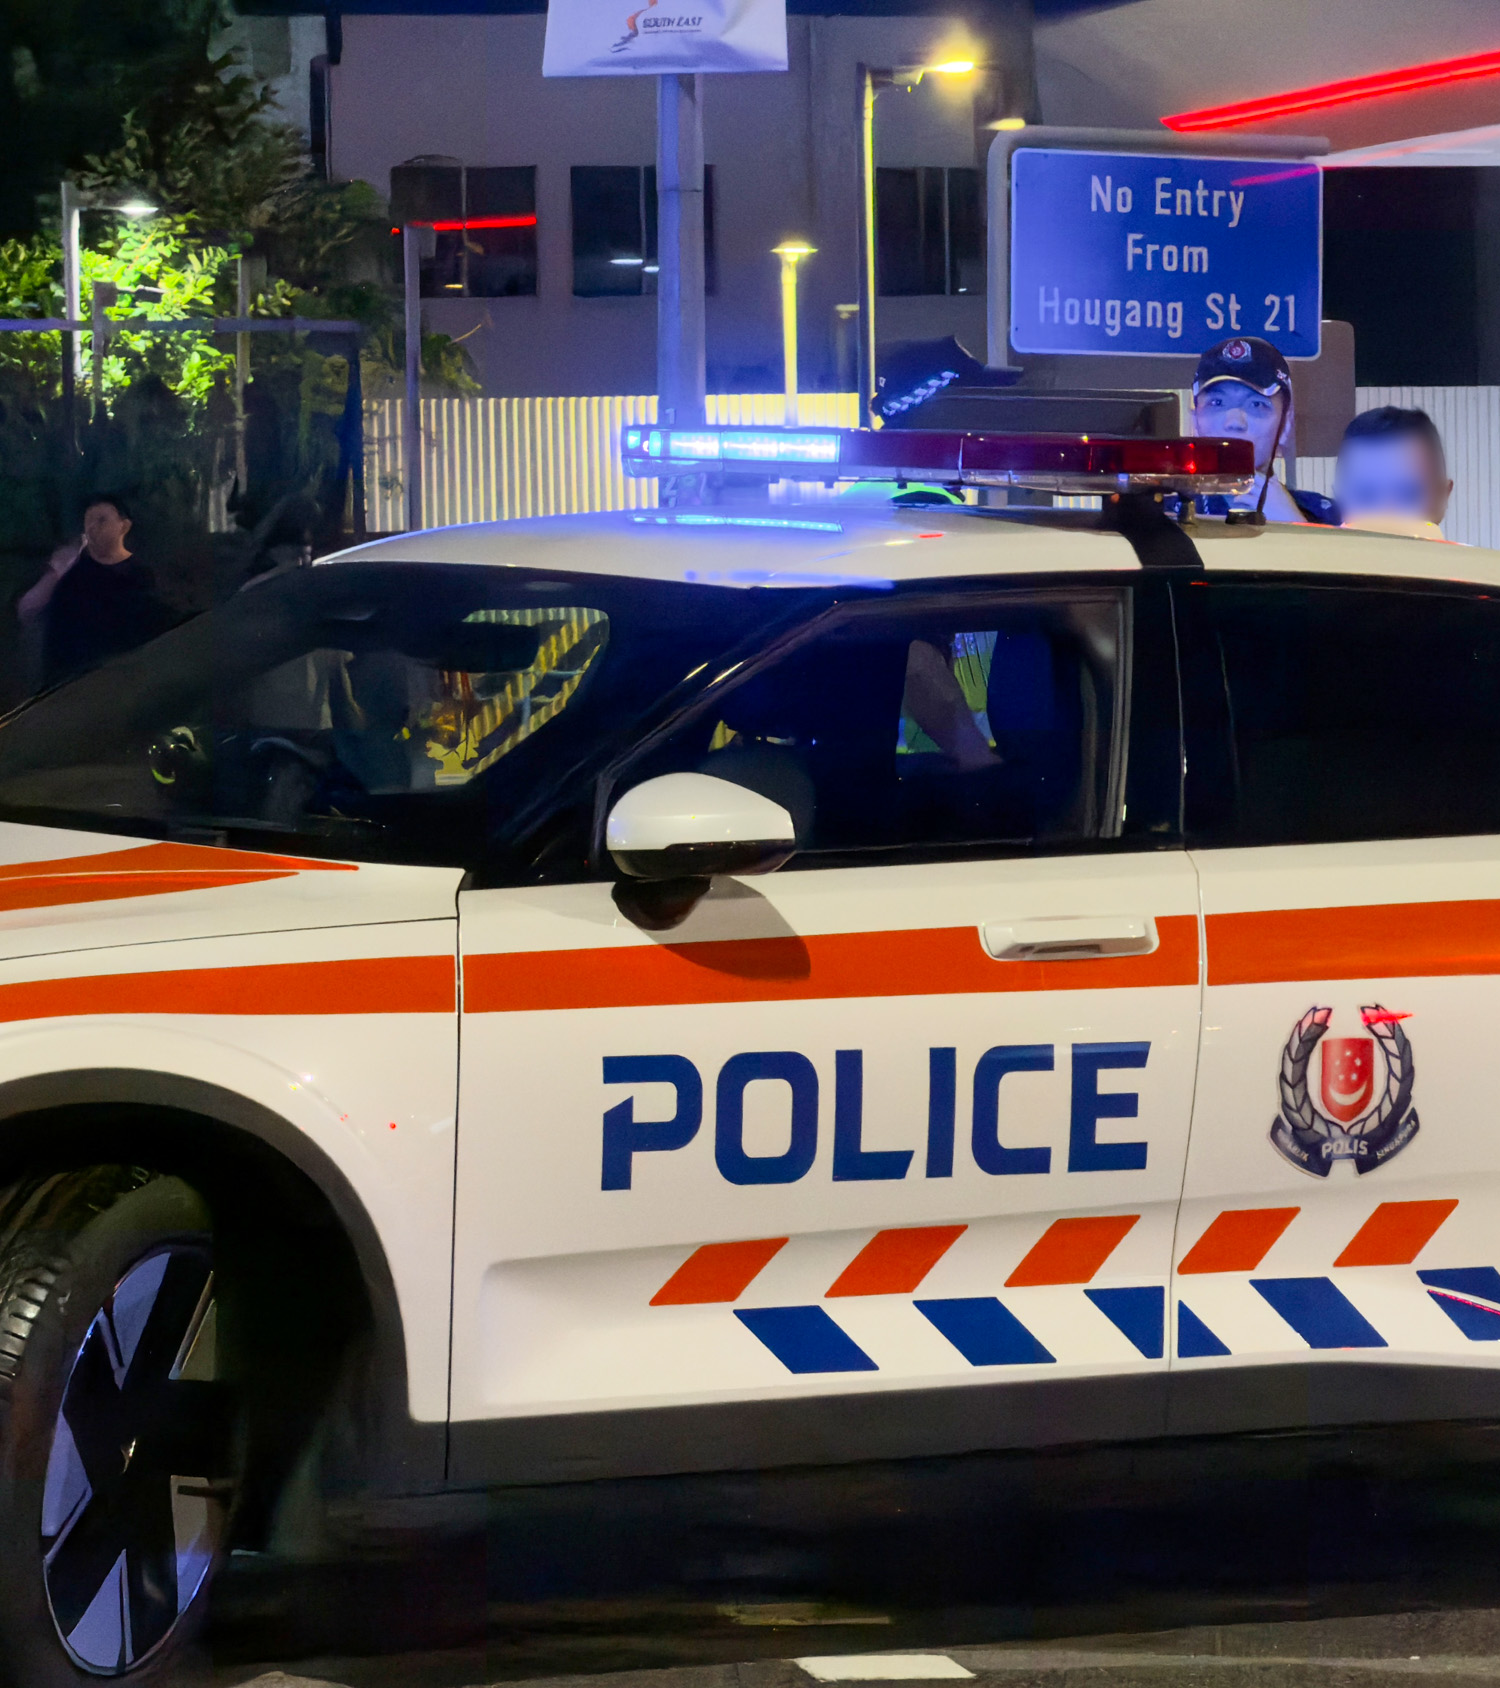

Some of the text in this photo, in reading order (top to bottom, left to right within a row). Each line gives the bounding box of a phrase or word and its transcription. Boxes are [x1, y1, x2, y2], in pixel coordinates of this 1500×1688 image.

[642, 16, 703, 28] SOUTH EAST
[1090, 175, 1245, 228] No Entry
[1126, 233, 1208, 273] From
[1038, 286, 1296, 338] Hougang St 21
[601, 1040, 1151, 1191] POLICE
[1321, 1138, 1369, 1159] POLIS
